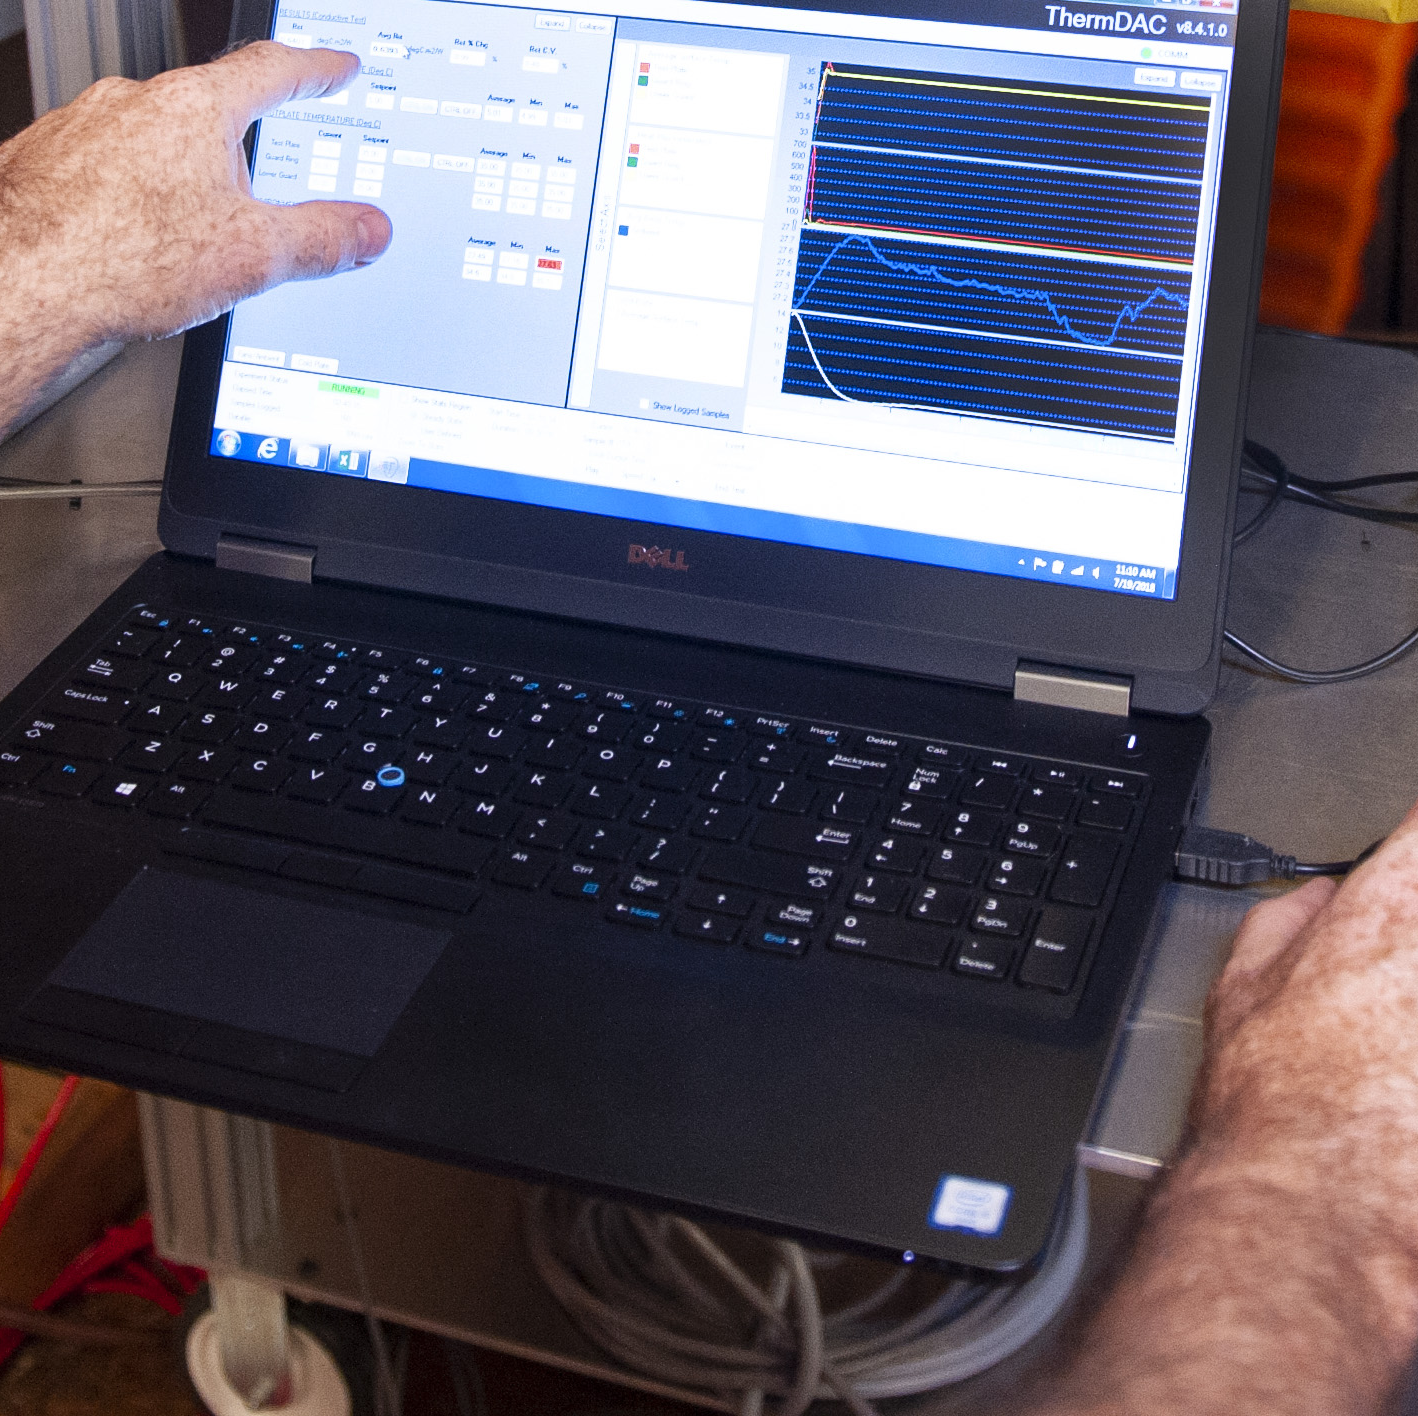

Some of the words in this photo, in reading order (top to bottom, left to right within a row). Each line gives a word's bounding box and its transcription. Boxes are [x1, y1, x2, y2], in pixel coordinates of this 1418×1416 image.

[1045, 5, 1167, 34] ThermDAC
[1176, 21, 1228, 37] v8.4.1.0
[1158, 49, 1189, 59] COMM
[794, 140, 807, 148] 700
[792, 151, 806, 159] 600
[331, 383, 366, 396] RUNNING
[628, 544, 689, 571] DELL
[1139, 568, 1156, 579] AM
[96, 659, 111, 668] Tab
[168, 673, 182, 683] Q
[219, 680, 238, 692] W
[64, 689, 90, 701] Caps
[91, 692, 108, 702] Lock
[271, 689, 286, 700] E
[147, 705, 160, 715] A
[324, 699, 338, 710] R
[201, 713, 215, 724] S
[380, 708, 392, 718] T
[32, 720, 55, 730] Shift
[253, 722, 268, 733] D
[435, 717, 447, 728] Y
[756, 717, 789, 729] PrtScr
[308, 732, 322, 742] F
[488, 727, 503, 739] U
[810, 726, 839, 737] Insert
[866, 735, 898, 746] Delete
[144, 741, 161, 752] Z
[362, 742, 377, 753] G
[926, 745, 948, 755] Calc
[1, 753, 20, 762] Ctrl
[198, 750, 214, 762] X
[417, 752, 433, 763] H
[599, 749, 615, 760] O
[253, 760, 268, 771] C
[657, 759, 671, 769] P
[834, 754, 887, 769] Backspace
[310, 769, 324, 780] V
[474, 764, 488, 774] J
[916, 768, 940, 778] Num
[361, 779, 377, 791] B
[530, 773, 545, 786] K
[419, 790, 436, 803] N
[589, 785, 600, 797] L
[476, 802, 495, 815] M
[901, 802, 912, 812] 7
[957, 812, 970, 823] 8
[891, 818, 921, 829] Home
[1017, 823, 1029, 833] 9
[822, 828, 852, 839] Enter
[882, 839, 894, 850] 4
[1009, 838, 1038, 850] PgUp
[941, 849, 953, 860] 5
[572, 864, 593, 874] Ctrl
[1000, 860, 1013, 872] 6
[867, 877, 874, 887] 1
[924, 888, 937, 899] 2
[985, 898, 998, 910] 3
[844, 916, 857, 928] 0
[1035, 938, 1065, 951] Enter
